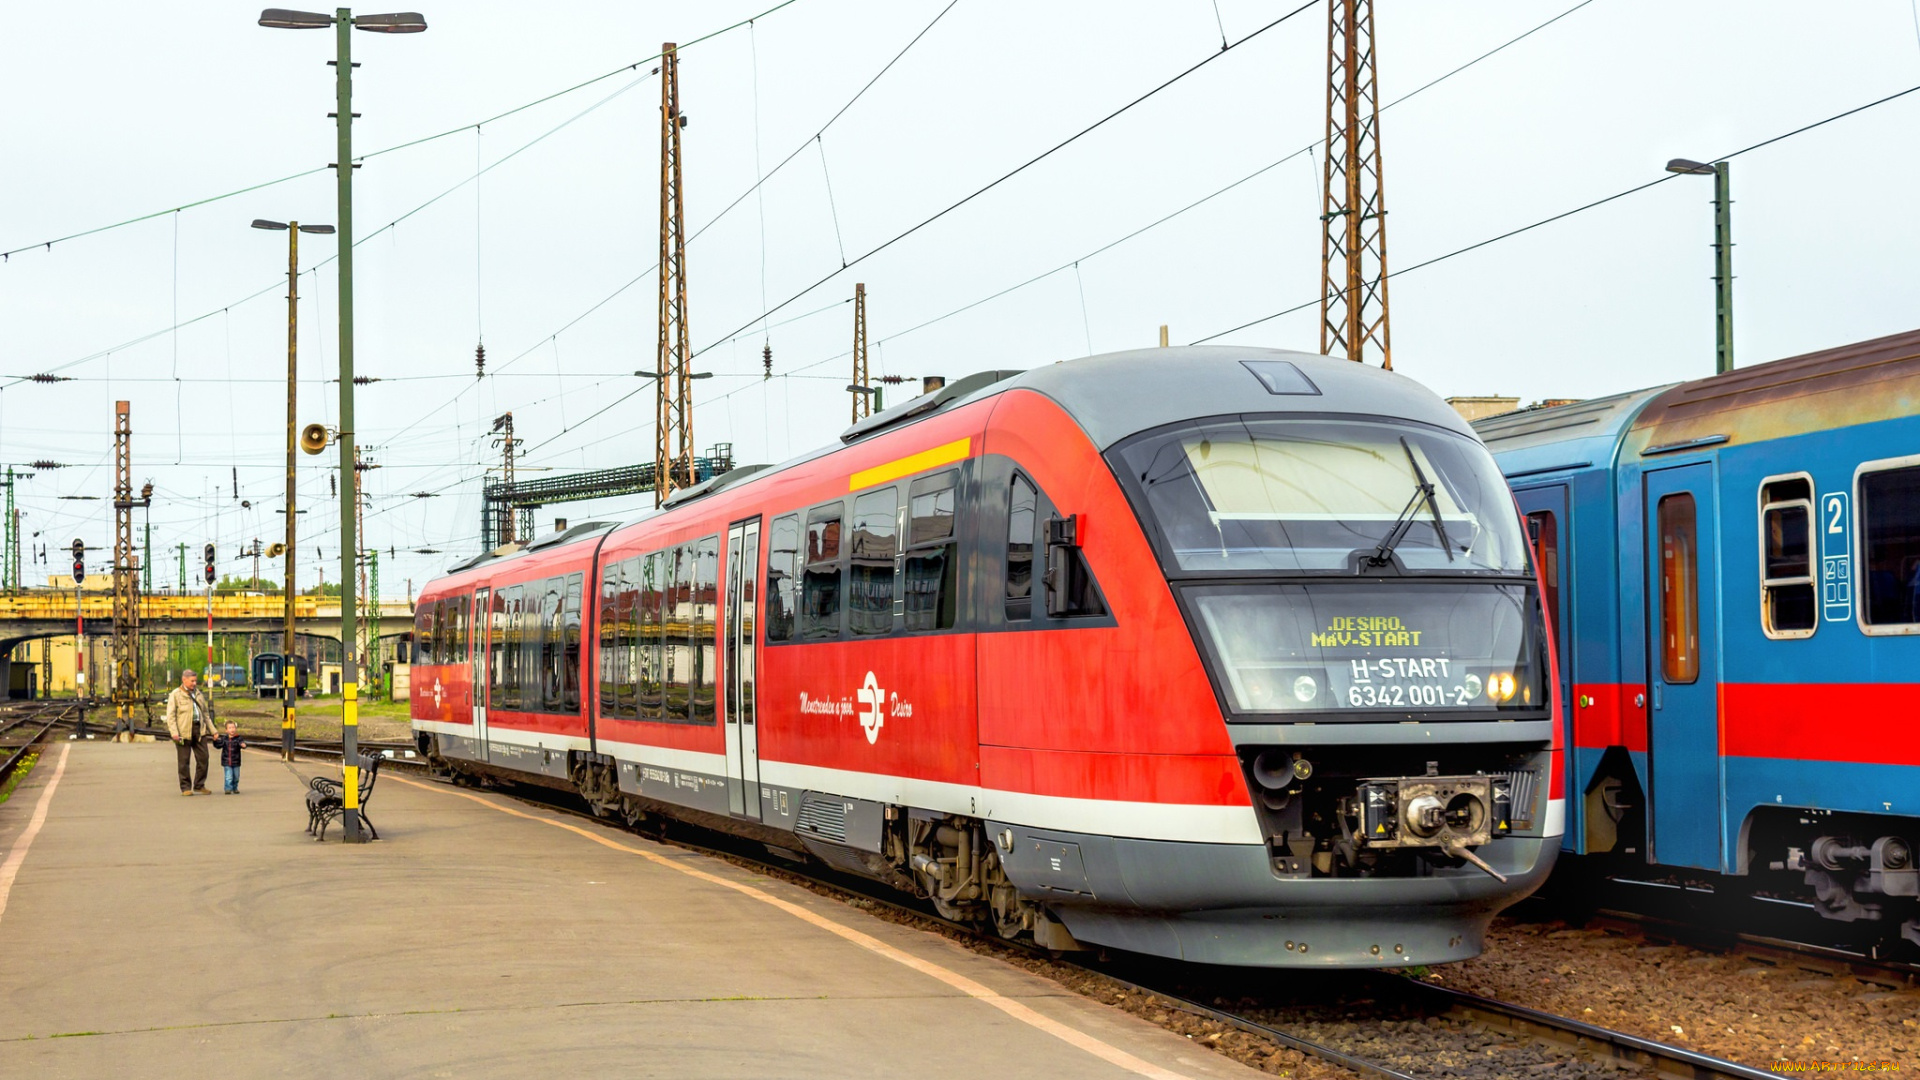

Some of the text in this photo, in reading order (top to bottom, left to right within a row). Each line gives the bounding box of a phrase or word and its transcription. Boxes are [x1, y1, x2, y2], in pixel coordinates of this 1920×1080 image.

[1828, 498, 1843, 534] 2
[898, 510, 905, 552] 1
[1351, 658, 1449, 683] H-START
[890, 691, 913, 718] Desiro
[1348, 685, 1468, 707] 6342 001-2
